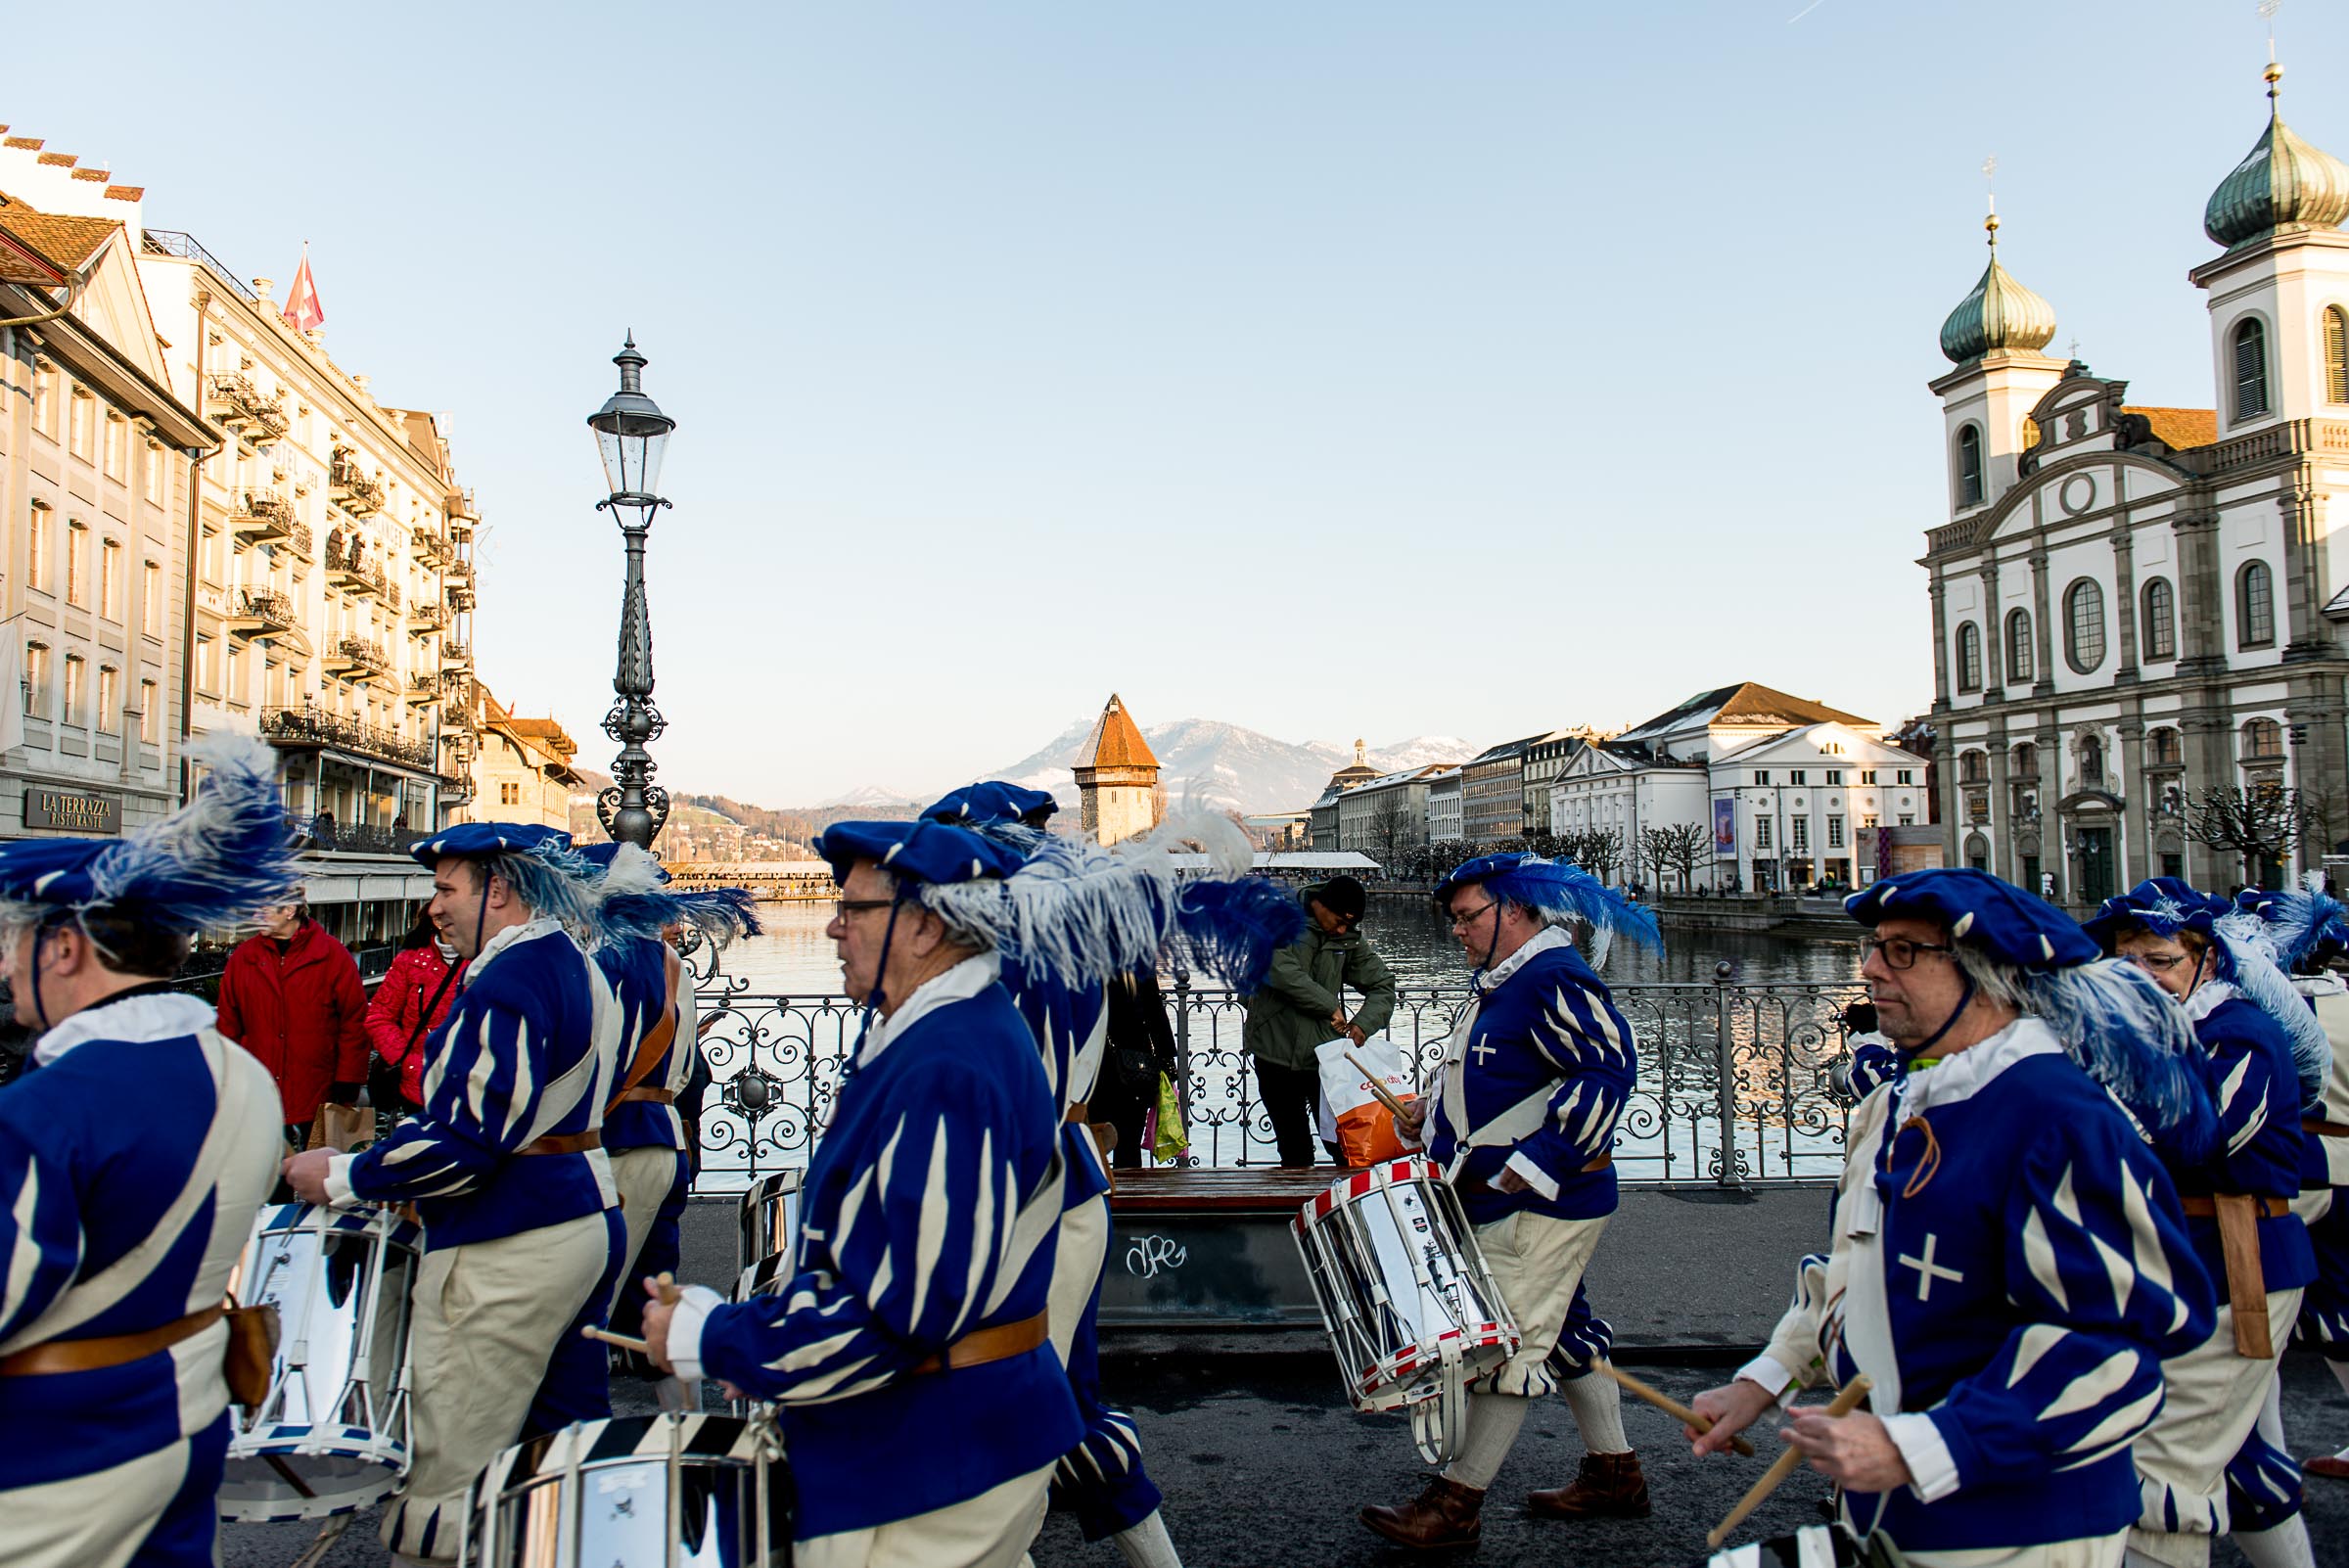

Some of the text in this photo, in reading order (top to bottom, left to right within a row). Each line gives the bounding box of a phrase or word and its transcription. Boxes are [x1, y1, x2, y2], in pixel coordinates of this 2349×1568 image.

[42, 794, 111, 817] LA TERRAZZA
[51, 812, 103, 828] RISTORANTE
